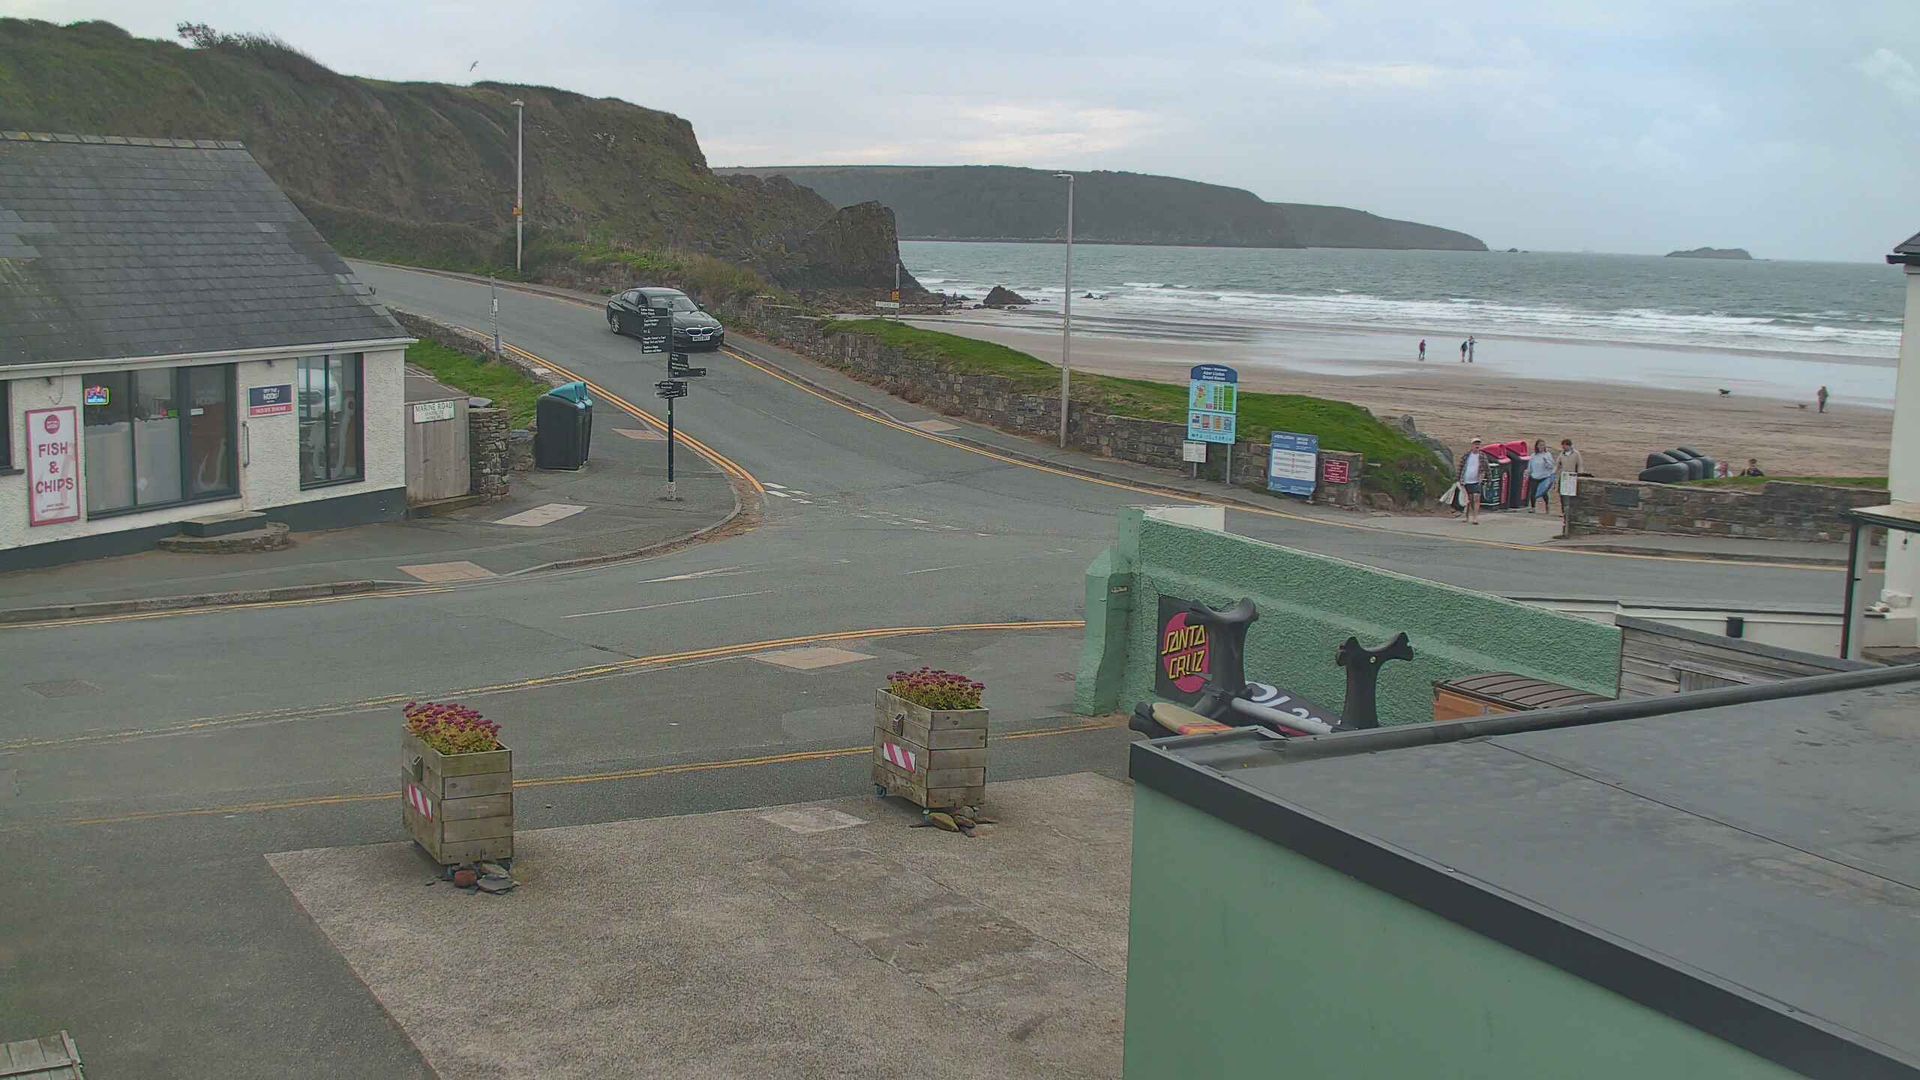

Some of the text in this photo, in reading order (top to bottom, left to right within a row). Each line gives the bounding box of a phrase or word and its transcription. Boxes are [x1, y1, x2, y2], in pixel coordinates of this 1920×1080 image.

[415, 401, 453, 412] MARINE ROAD
[39, 442, 68, 458] FISH
[49, 461, 59, 474] &
[36, 477, 74, 494] CHIPS
[1161, 625, 1206, 655] SANTA
[1168, 651, 1206, 680] CRUZ
